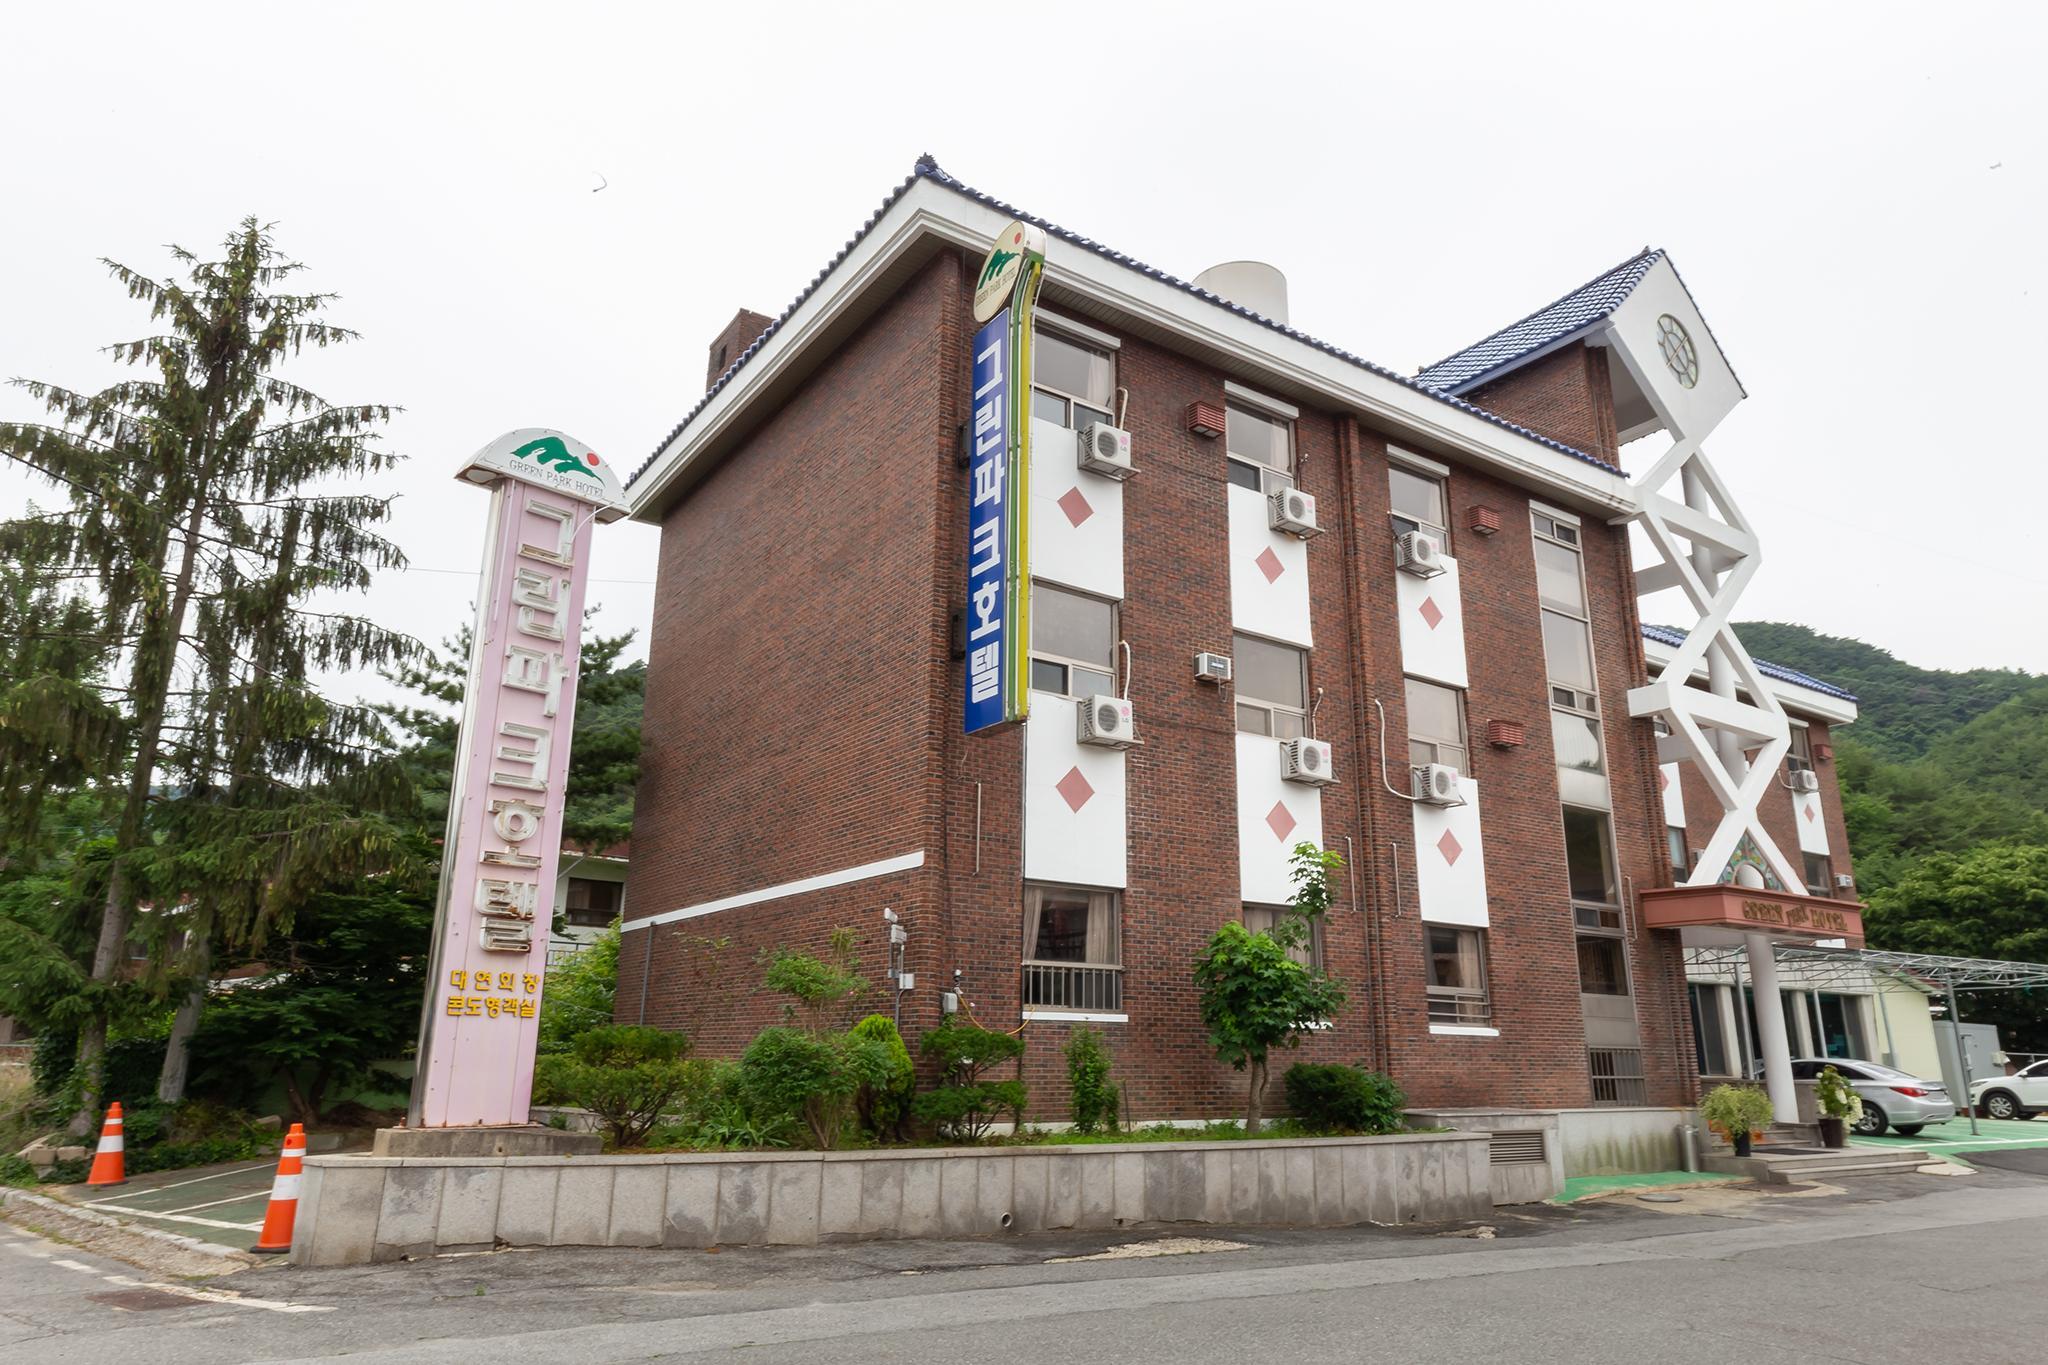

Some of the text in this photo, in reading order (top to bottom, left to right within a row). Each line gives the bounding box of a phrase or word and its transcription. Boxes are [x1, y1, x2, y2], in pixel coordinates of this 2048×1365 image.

[509, 459, 603, 497] GREEN PARK HOTEL
[971, 339, 1006, 704] 그린파크호텔
[475, 498, 575, 954] 그린파크호텔
[1742, 898, 1785, 923] GREEN
[1810, 908, 1849, 931] HOTEL
[450, 969, 540, 995] 대연회장
